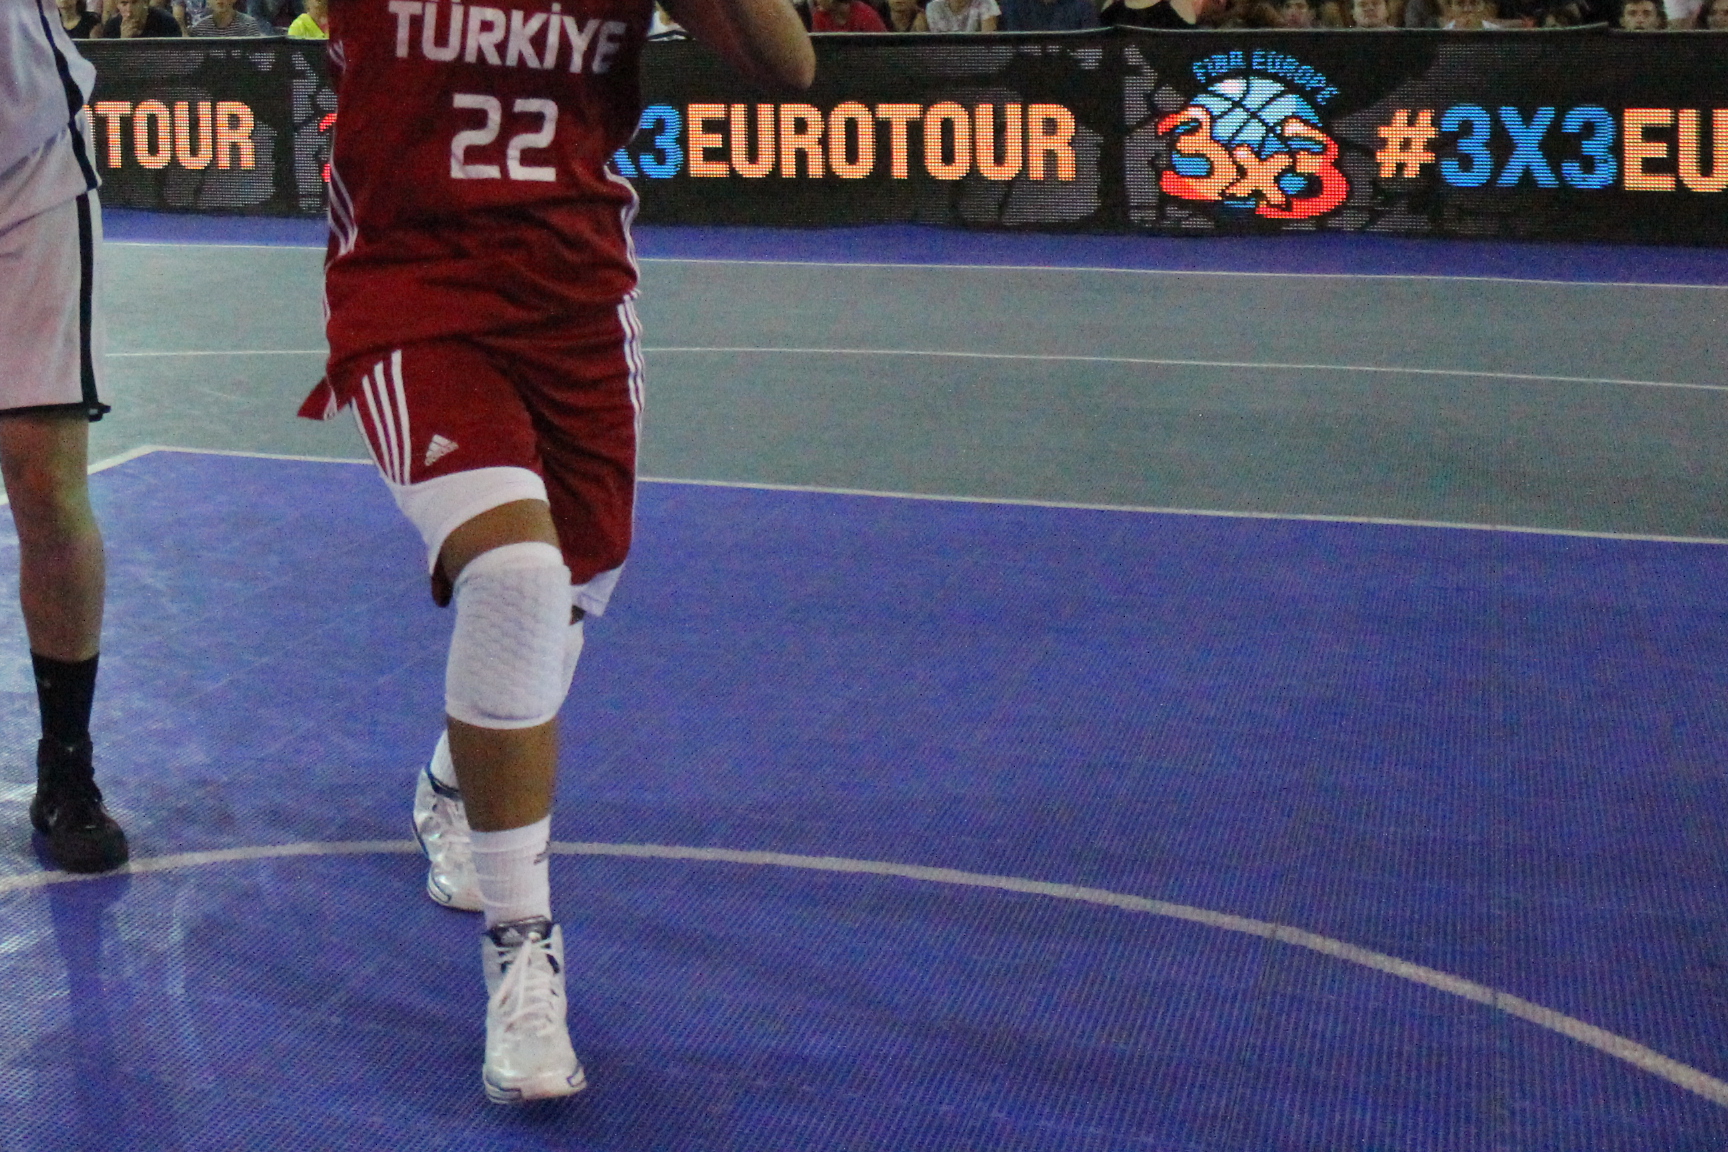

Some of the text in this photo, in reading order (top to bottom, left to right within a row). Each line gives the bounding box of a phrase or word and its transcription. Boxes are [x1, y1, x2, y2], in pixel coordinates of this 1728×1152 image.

[1252, 49, 1341, 105] EUROPE
[83, 98, 256, 170] TOUR
[450, 92, 559, 182] 22
